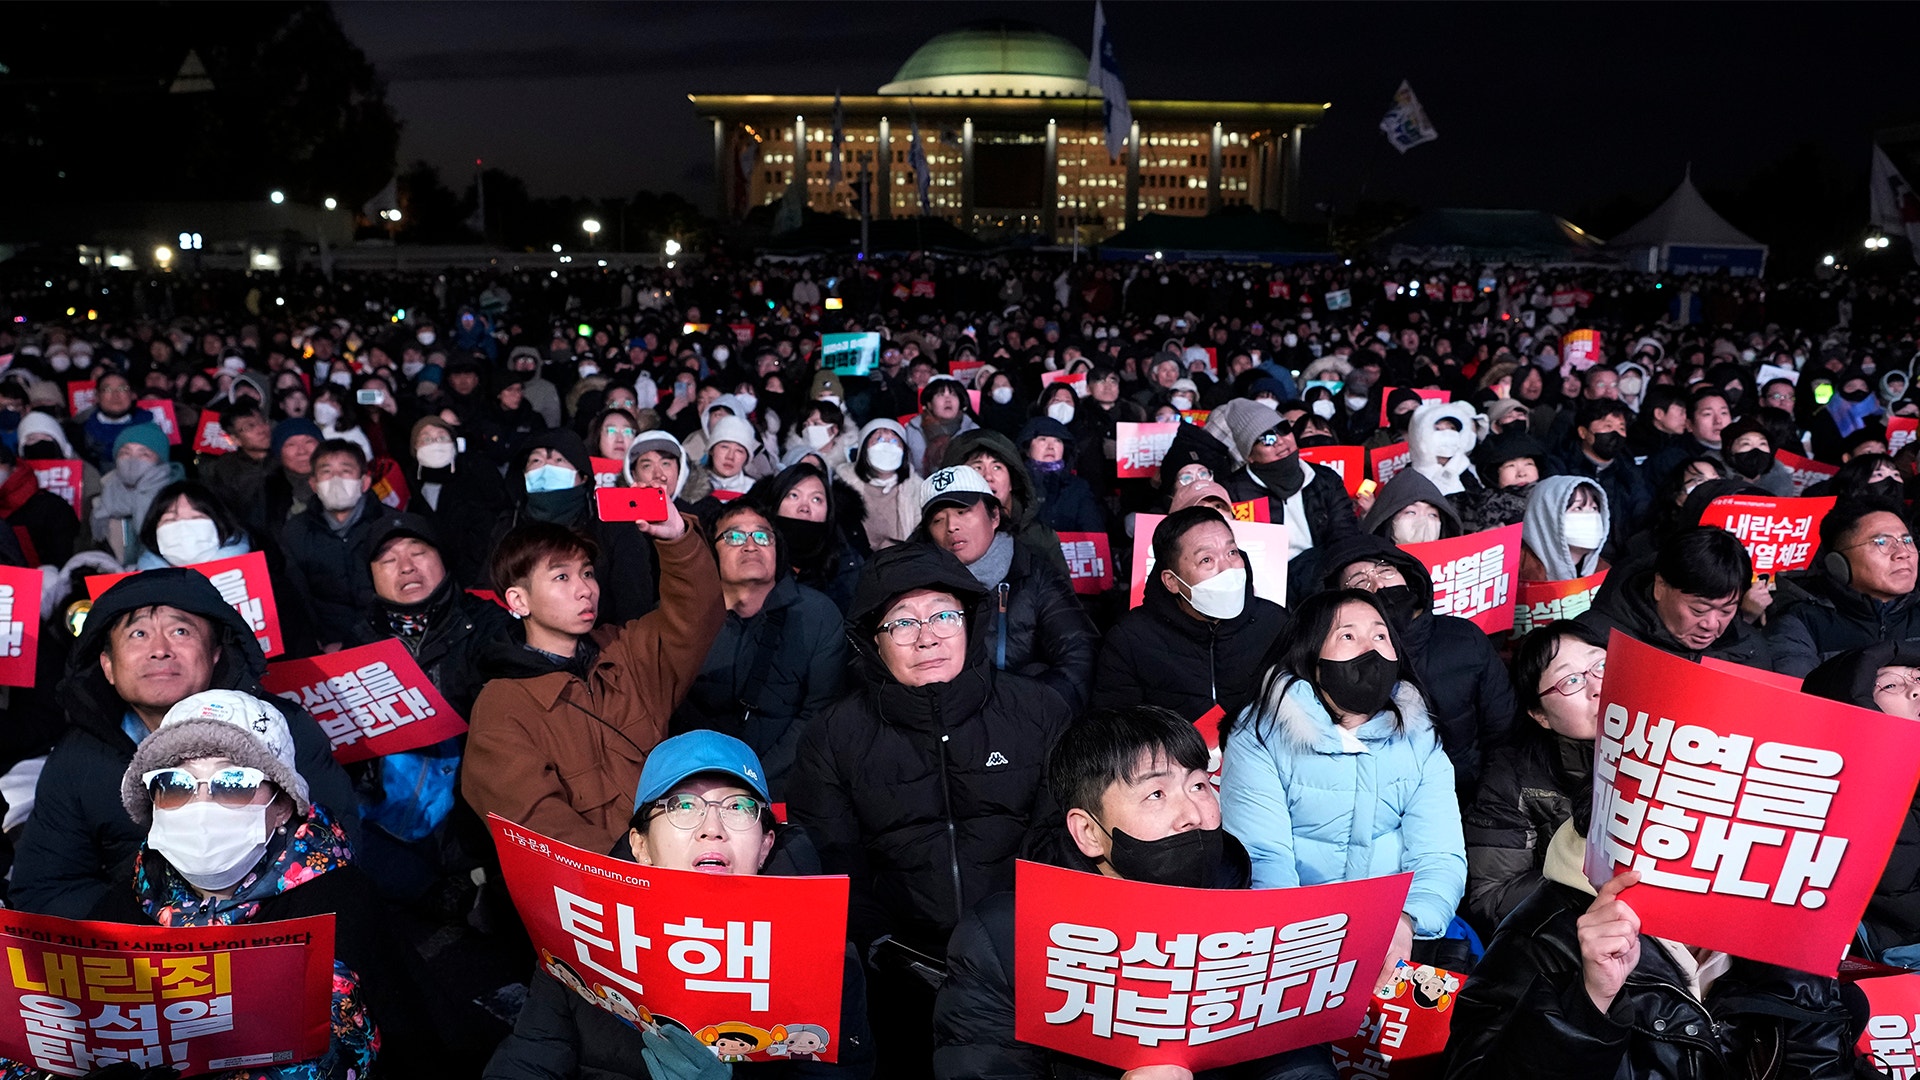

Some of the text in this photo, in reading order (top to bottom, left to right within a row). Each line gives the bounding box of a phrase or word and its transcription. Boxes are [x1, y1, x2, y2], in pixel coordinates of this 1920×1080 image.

[1725, 514, 1813, 542] 내란수괴
[1776, 543, 1811, 567] 체포
[1431, 544, 1505, 595] 석열을
[1514, 585, 1602, 624] 윤석열
[317, 686, 437, 751] 부한다!
[742, 764, 758, 781] Lee
[1598, 702, 1844, 831] 윤석열을
[503, 828, 651, 888] 나눔문화 www.nanum.com
[1591, 777, 1849, 909] 거부한다!
[6, 946, 232, 1002] 내란죄
[553, 885, 772, 1012] 탄핵
[1045, 913, 1349, 991] 윤석열을
[19, 994, 234, 1046] 윤석열
[1045, 959, 1358, 1047] 거부한다!
